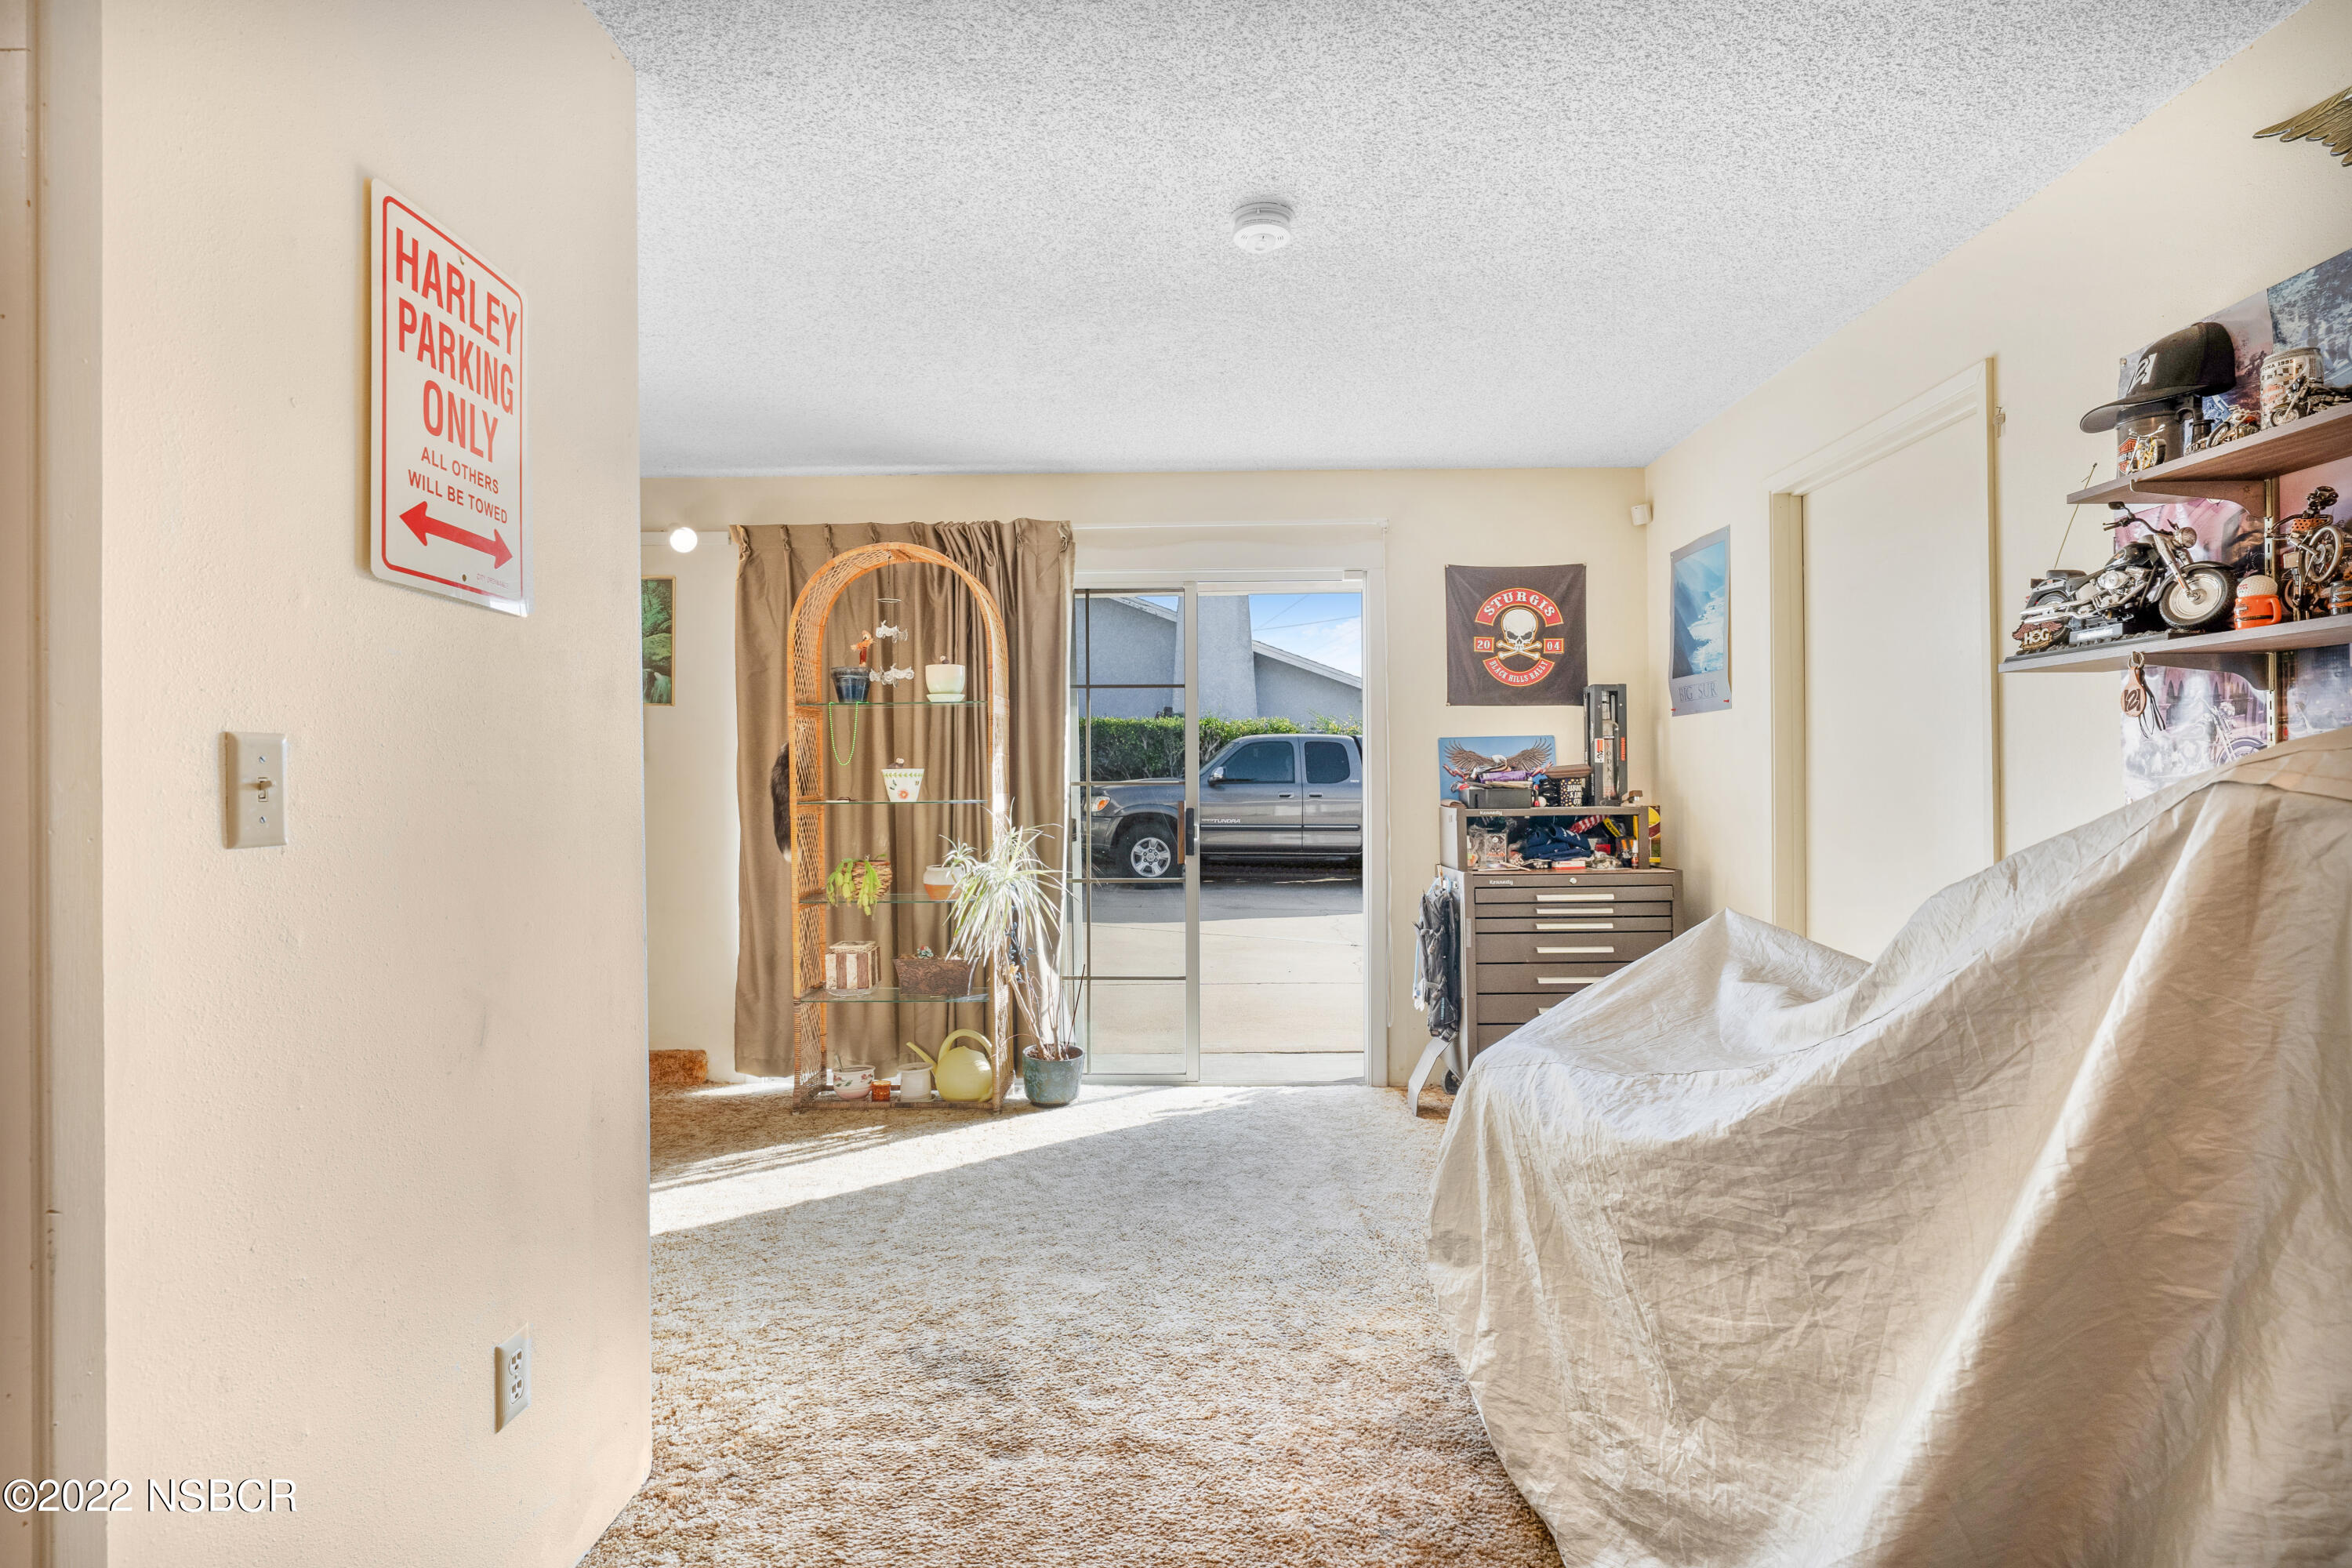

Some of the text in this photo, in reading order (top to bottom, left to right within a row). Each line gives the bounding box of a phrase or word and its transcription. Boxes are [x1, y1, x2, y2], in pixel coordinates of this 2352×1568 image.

[396, 227, 517, 356] HARLEY
[398, 296, 514, 415] PARKING
[423, 379, 498, 463] ONLY
[421, 446, 499, 494] ALL OTHERS
[408, 469, 507, 524] WILL BE TOWED
[1484, 591, 1555, 617] STURGIS
[1477, 640, 1561, 650] 20 04
[2024, 628, 2049, 645] HOG
[1489, 660, 1549, 683] BLACK HILLS RALLY
[1679, 682, 1719, 703] BIG SUR
